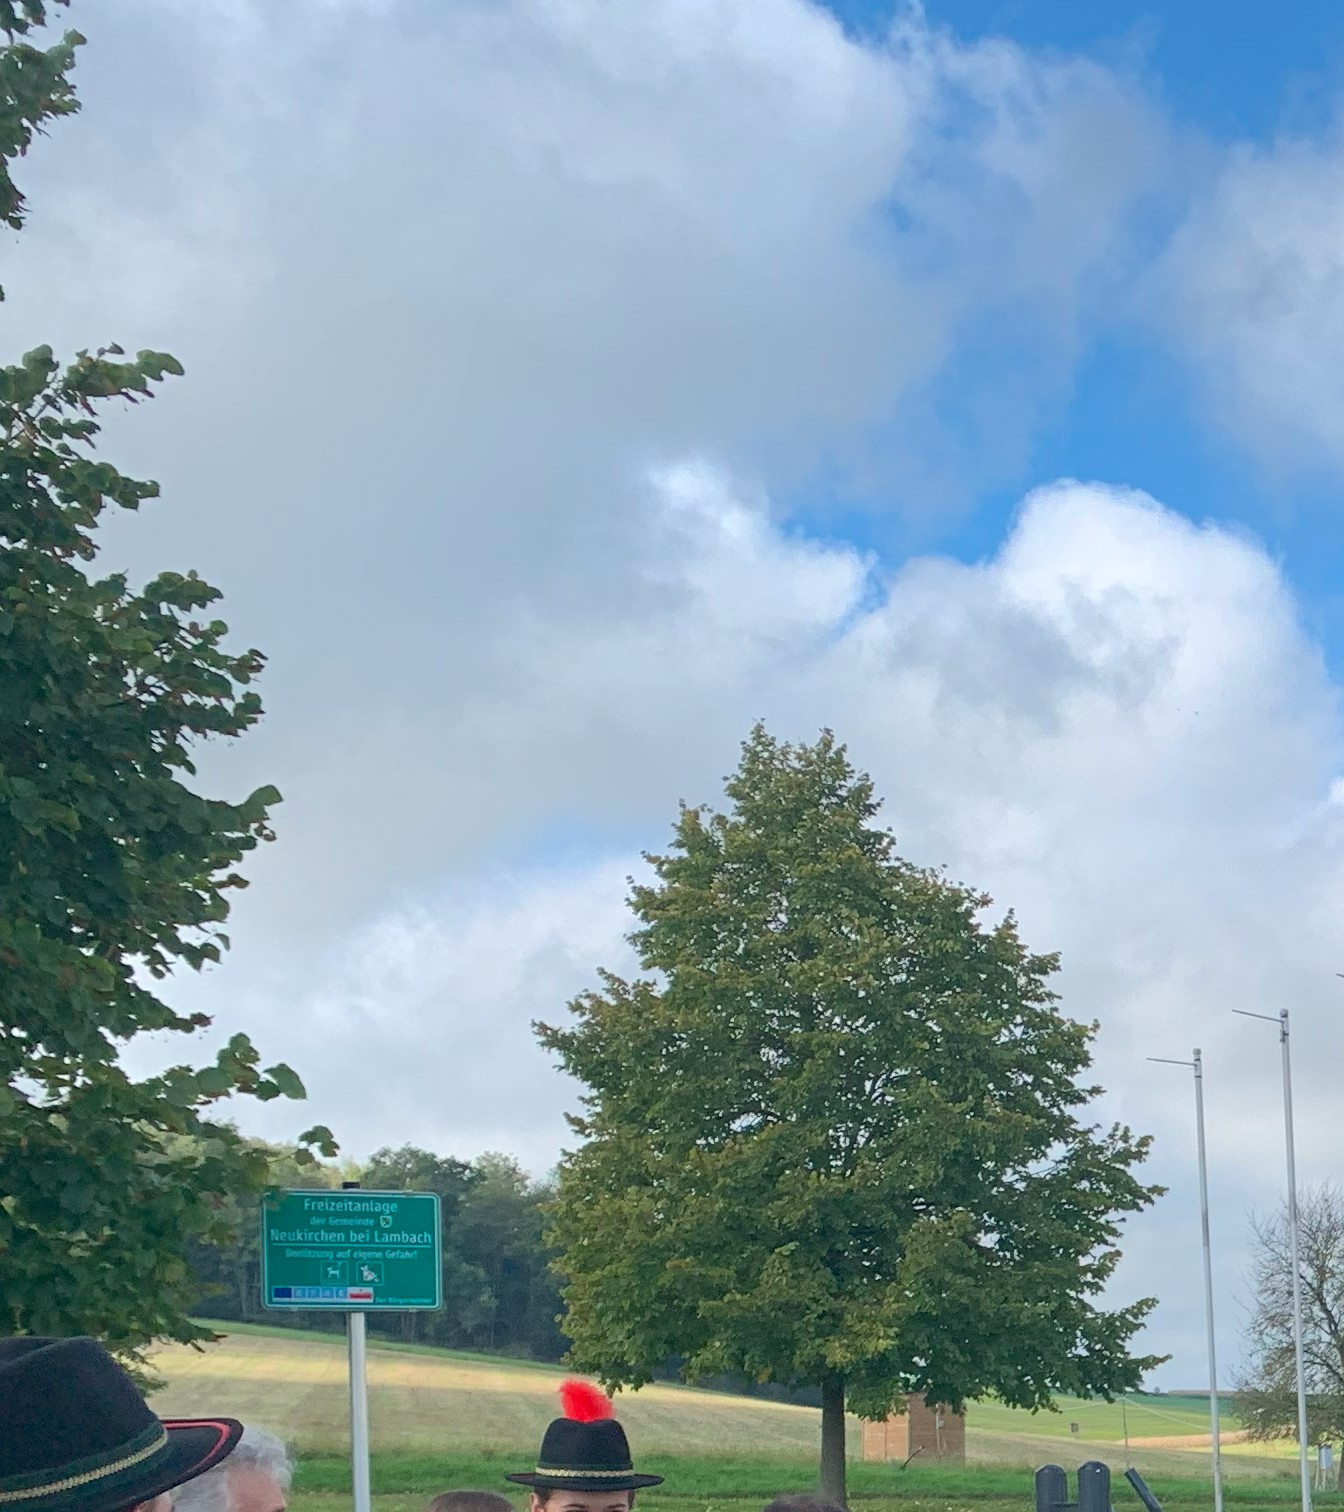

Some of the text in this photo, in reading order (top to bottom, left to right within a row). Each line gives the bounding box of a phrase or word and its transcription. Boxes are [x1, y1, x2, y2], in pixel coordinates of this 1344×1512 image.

[304, 1199, 398, 1215] Freizeitanlage
[310, 1216, 326, 1225] der
[270, 1228, 432, 1244] Neukirchen bei Lambach
[353, 1250, 383, 1260] eigene
